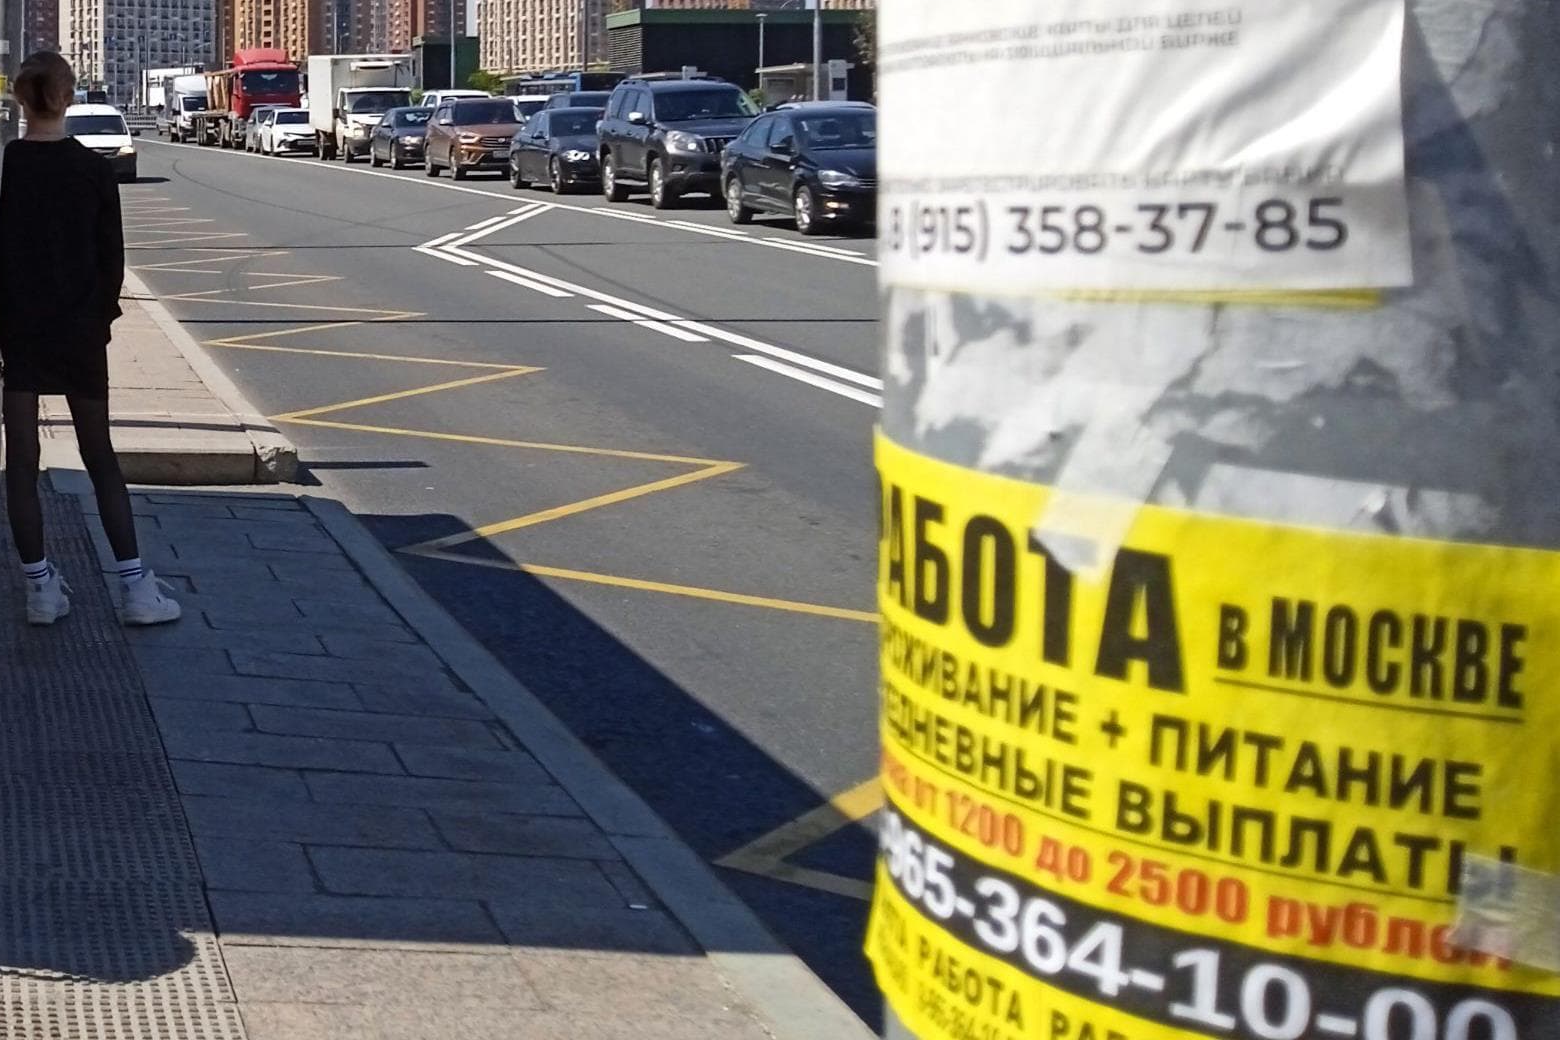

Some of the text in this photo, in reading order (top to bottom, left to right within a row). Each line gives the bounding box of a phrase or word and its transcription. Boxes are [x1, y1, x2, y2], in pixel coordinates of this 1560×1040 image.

[910, 200, 990, 263] (915)
[1007, 195, 1349, 255] 358-37-85
[1268, 597, 1528, 710] МОСКВЕ
[1100, 710, 1127, 749] +
[1149, 712, 1484, 820] ПИТАНИЕ
[944, 788, 1025, 859] 1200
[1035, 835, 1092, 884] до
[1105, 849, 1249, 927] 2500
